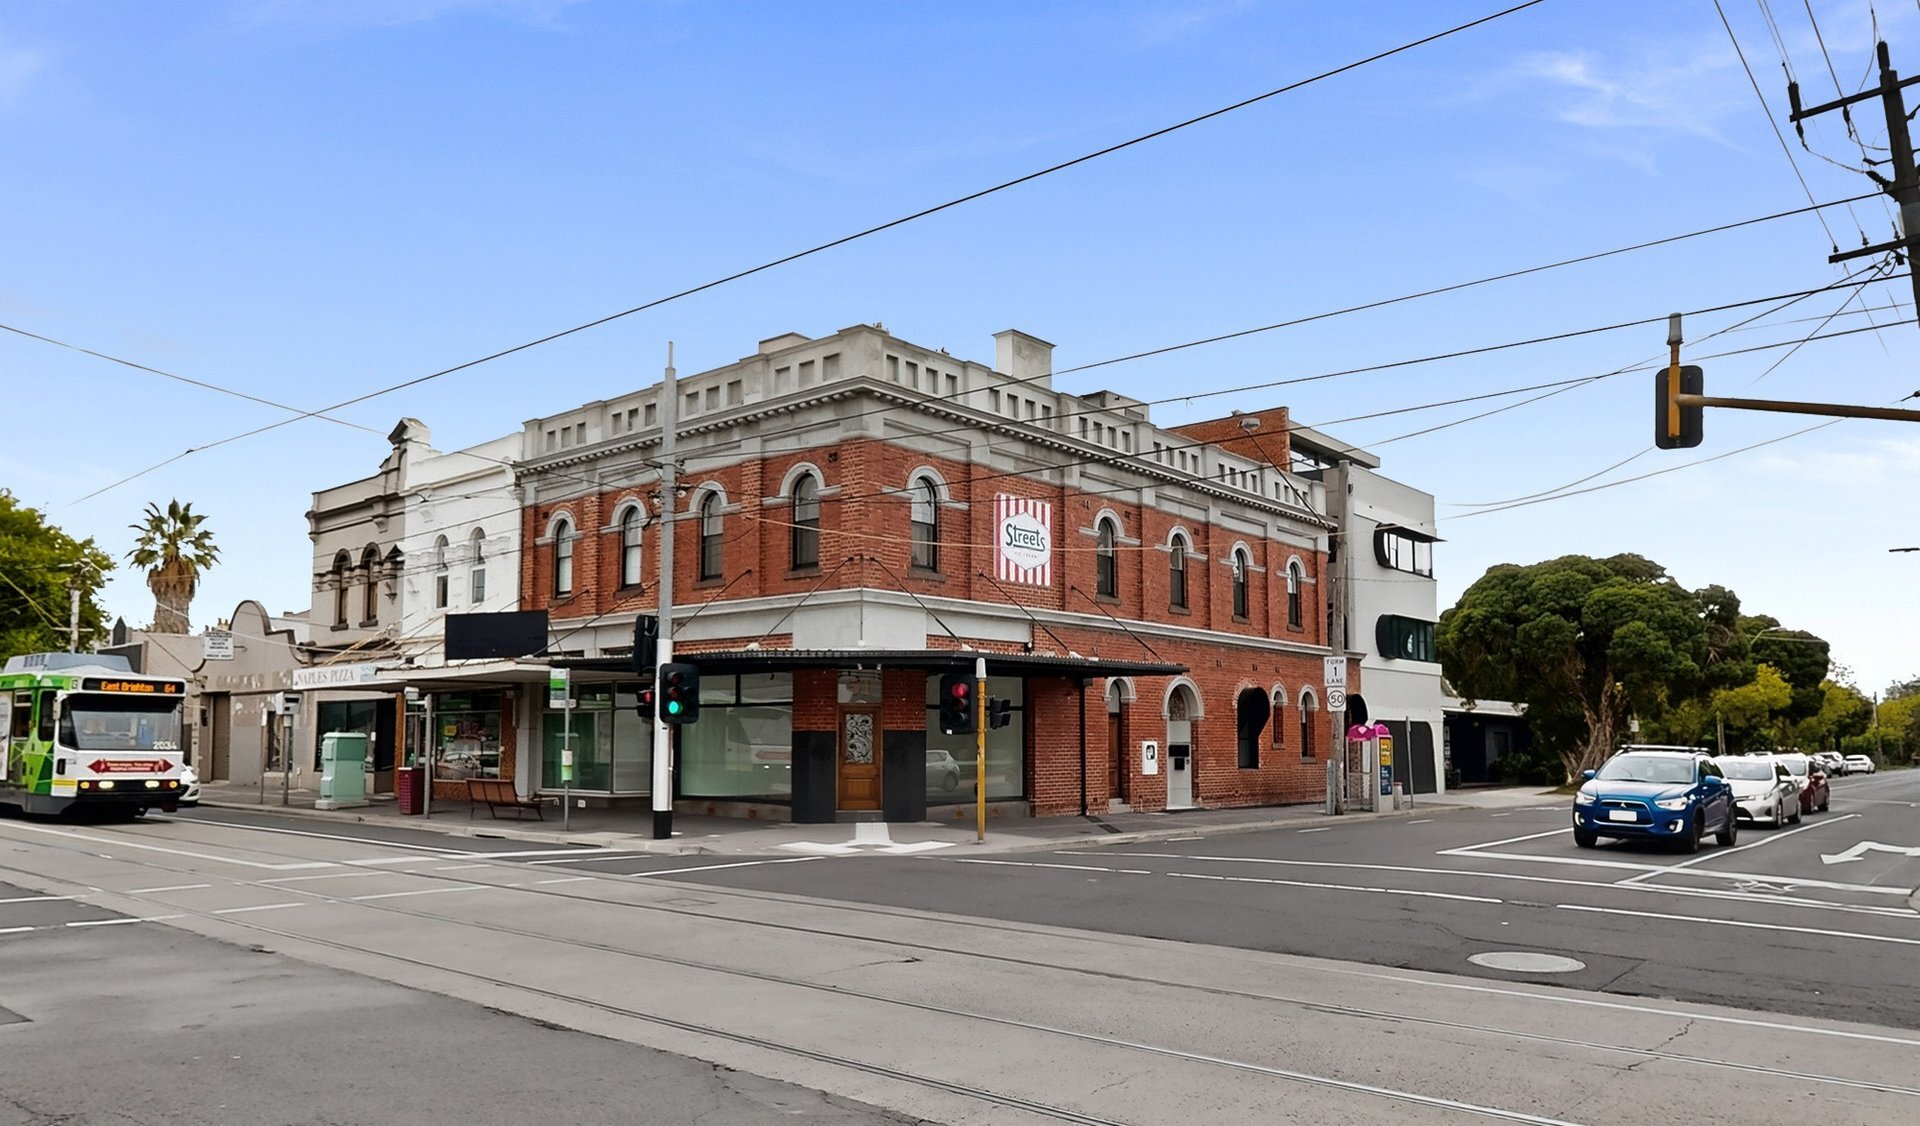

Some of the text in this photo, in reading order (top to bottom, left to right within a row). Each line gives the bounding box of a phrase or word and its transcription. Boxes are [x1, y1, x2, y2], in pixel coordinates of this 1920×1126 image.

[1005, 523, 1046, 552] Streets
[330, 668, 355, 683] PIZZA
[1333, 666, 1338, 676] 1
[101, 681, 120, 691] East
[121, 681, 155, 693] Brighton
[1330, 694, 1344, 704] 50
[152, 740, 178, 750] 2034
